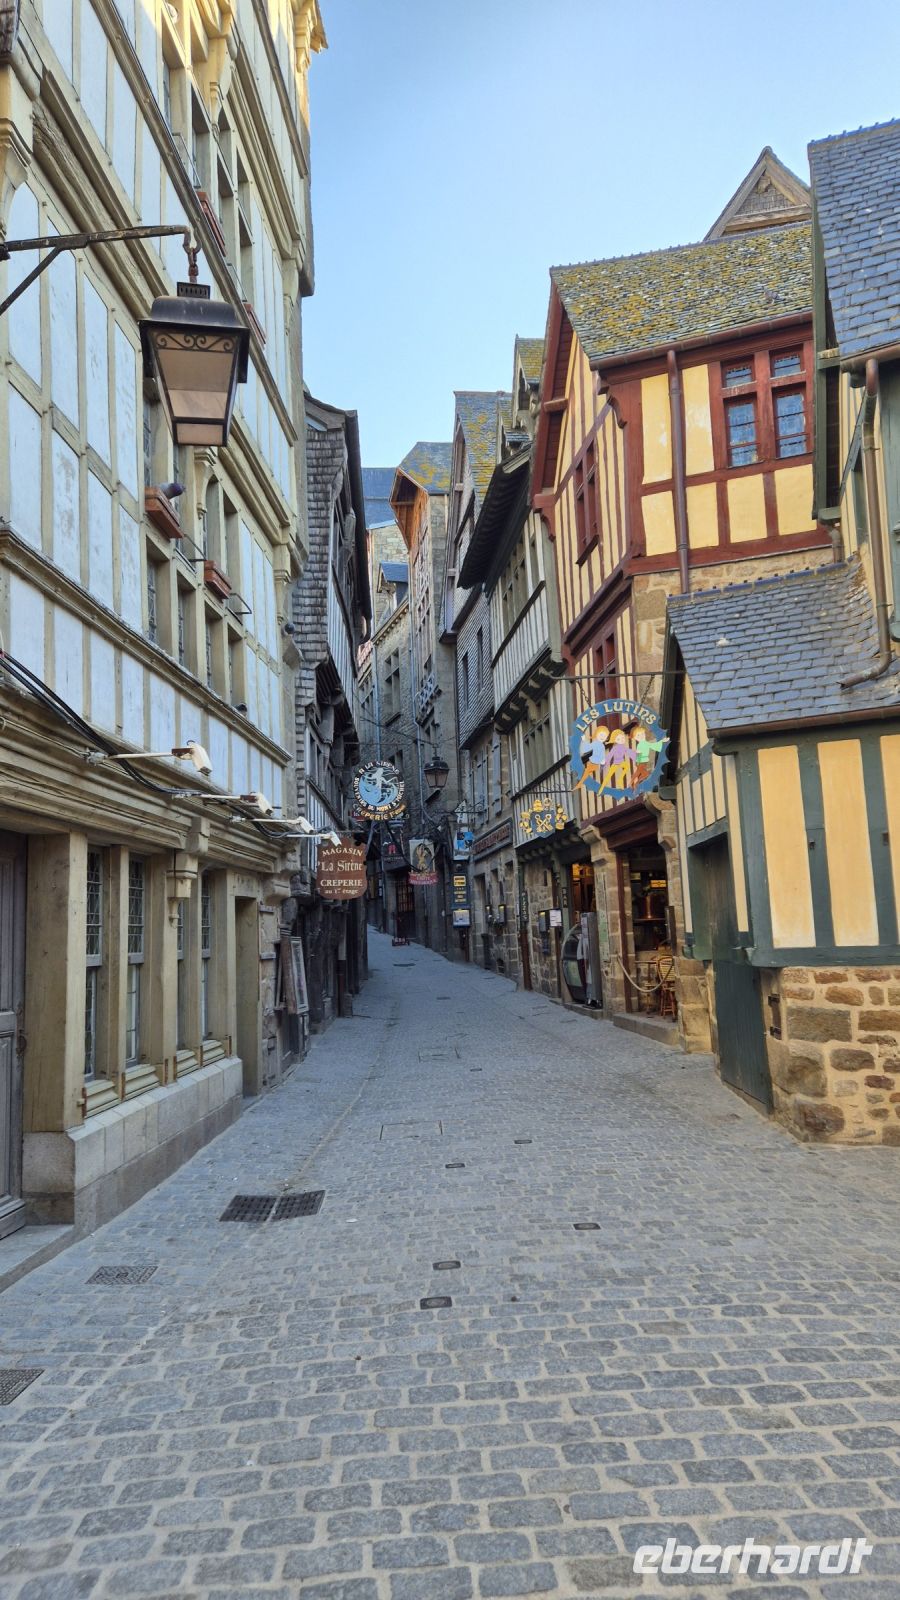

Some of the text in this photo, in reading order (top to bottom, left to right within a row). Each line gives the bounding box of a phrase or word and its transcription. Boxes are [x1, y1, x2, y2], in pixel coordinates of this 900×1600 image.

[576, 701, 657, 732] LES LUTINS
[365, 761, 374, 770] LA
[376, 804, 392, 812] MONT
[395, 780, 405, 803] MICHEL
[322, 847, 363, 857] MAGASIN
[337, 859, 363, 873] Sirène
[320, 879, 363, 887] CREPERIE
